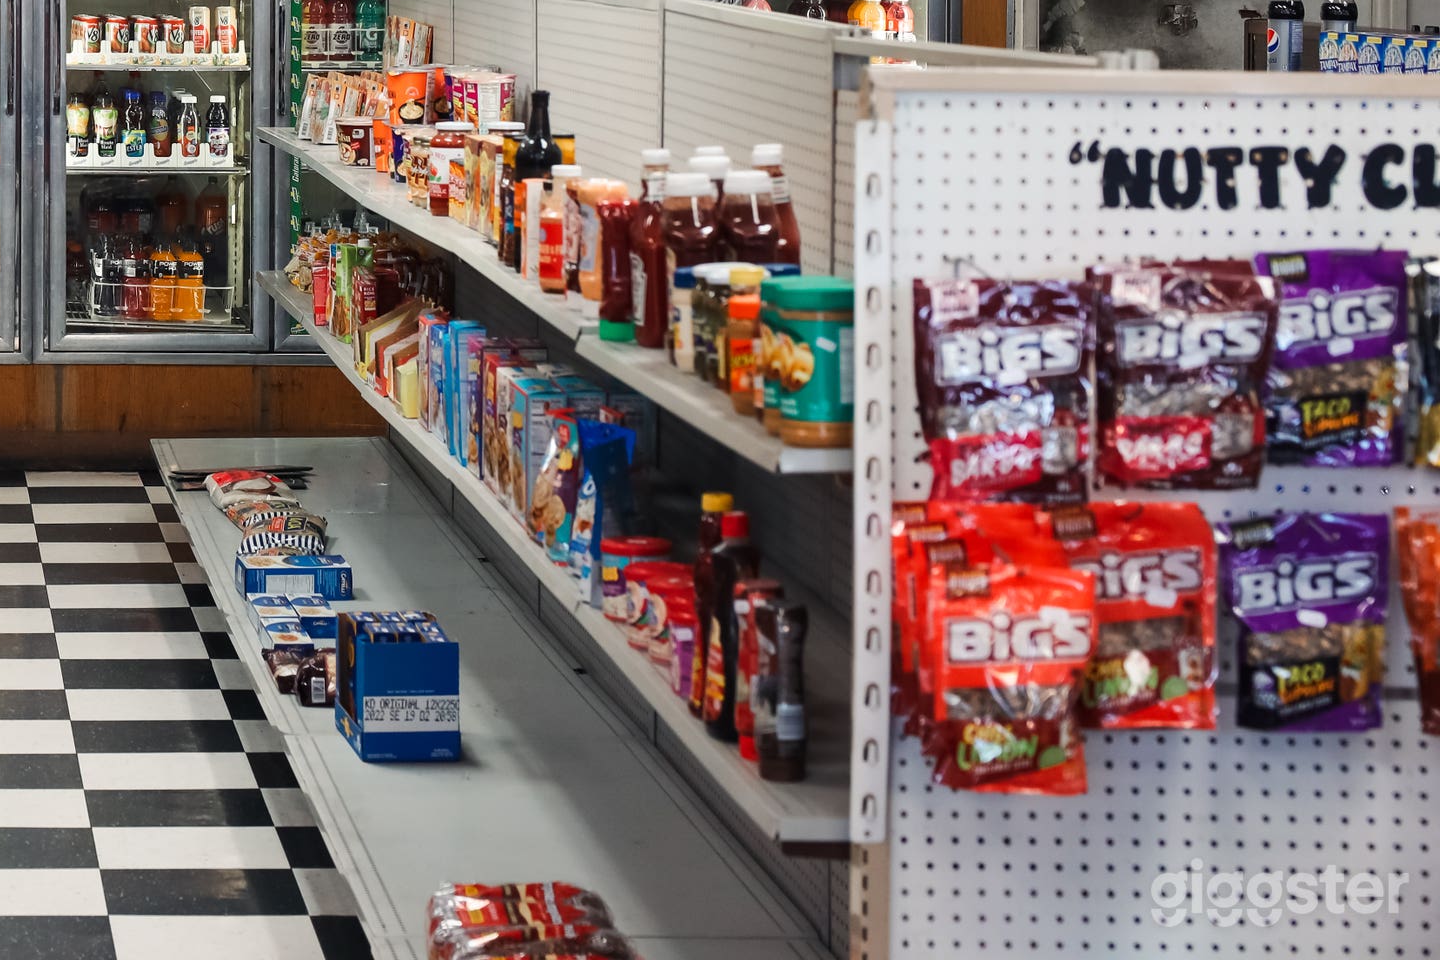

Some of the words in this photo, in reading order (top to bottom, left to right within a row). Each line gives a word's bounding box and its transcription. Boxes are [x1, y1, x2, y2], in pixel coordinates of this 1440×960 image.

[87, 29, 99, 42] V8
[303, 33, 320, 41] ZERO
[332, 33, 351, 41] ZERO
[1338, 61, 1358, 73] TAMPAX
[1068, 140, 1347, 210] “NUTTY
[364, 699, 375, 710] KD
[379, 699, 420, 710] ORIGINAL
[364, 710, 385, 721] 2022
[389, 710, 400, 721] SE
